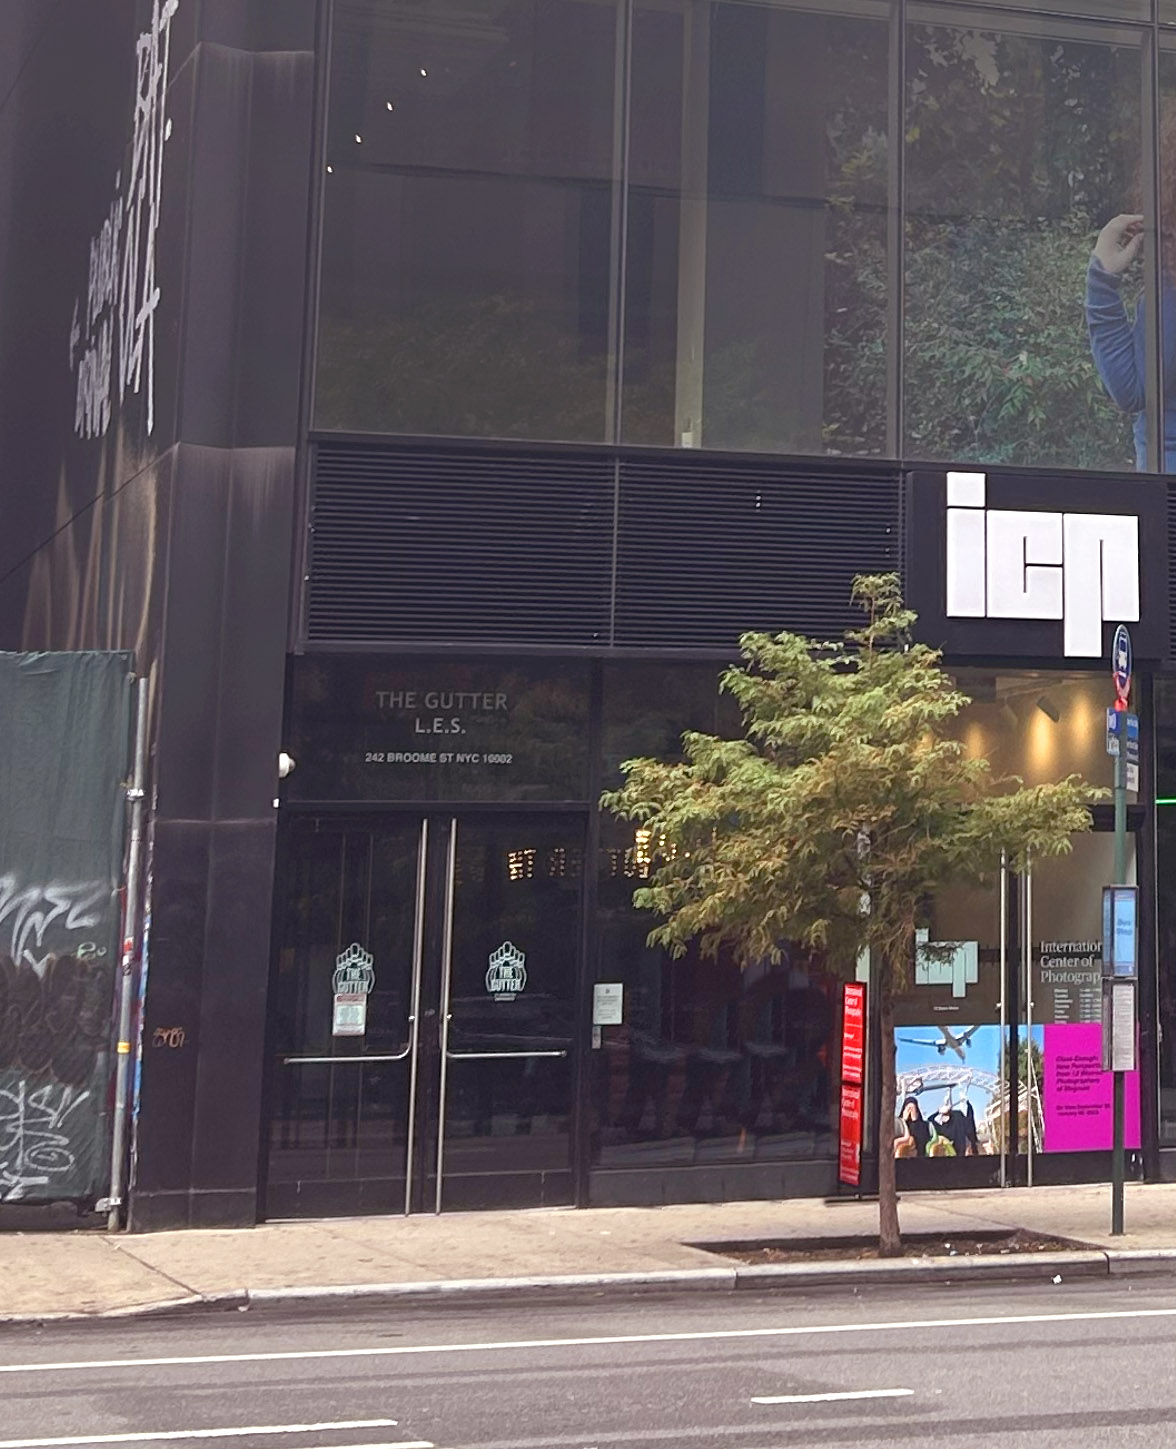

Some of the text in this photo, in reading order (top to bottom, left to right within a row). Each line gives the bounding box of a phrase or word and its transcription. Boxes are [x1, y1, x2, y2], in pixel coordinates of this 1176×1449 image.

[375, 691, 508, 710] THE GUTTER
[415, 717, 466, 734] L.E.S.
[365, 752, 385, 763] 242
[387, 752, 437, 763] BROOME
[439, 753, 453, 764] ST
[455, 753, 480, 764] NYC
[1040, 954, 1095, 968] Center of
[1040, 970, 1101, 985] Photograp
